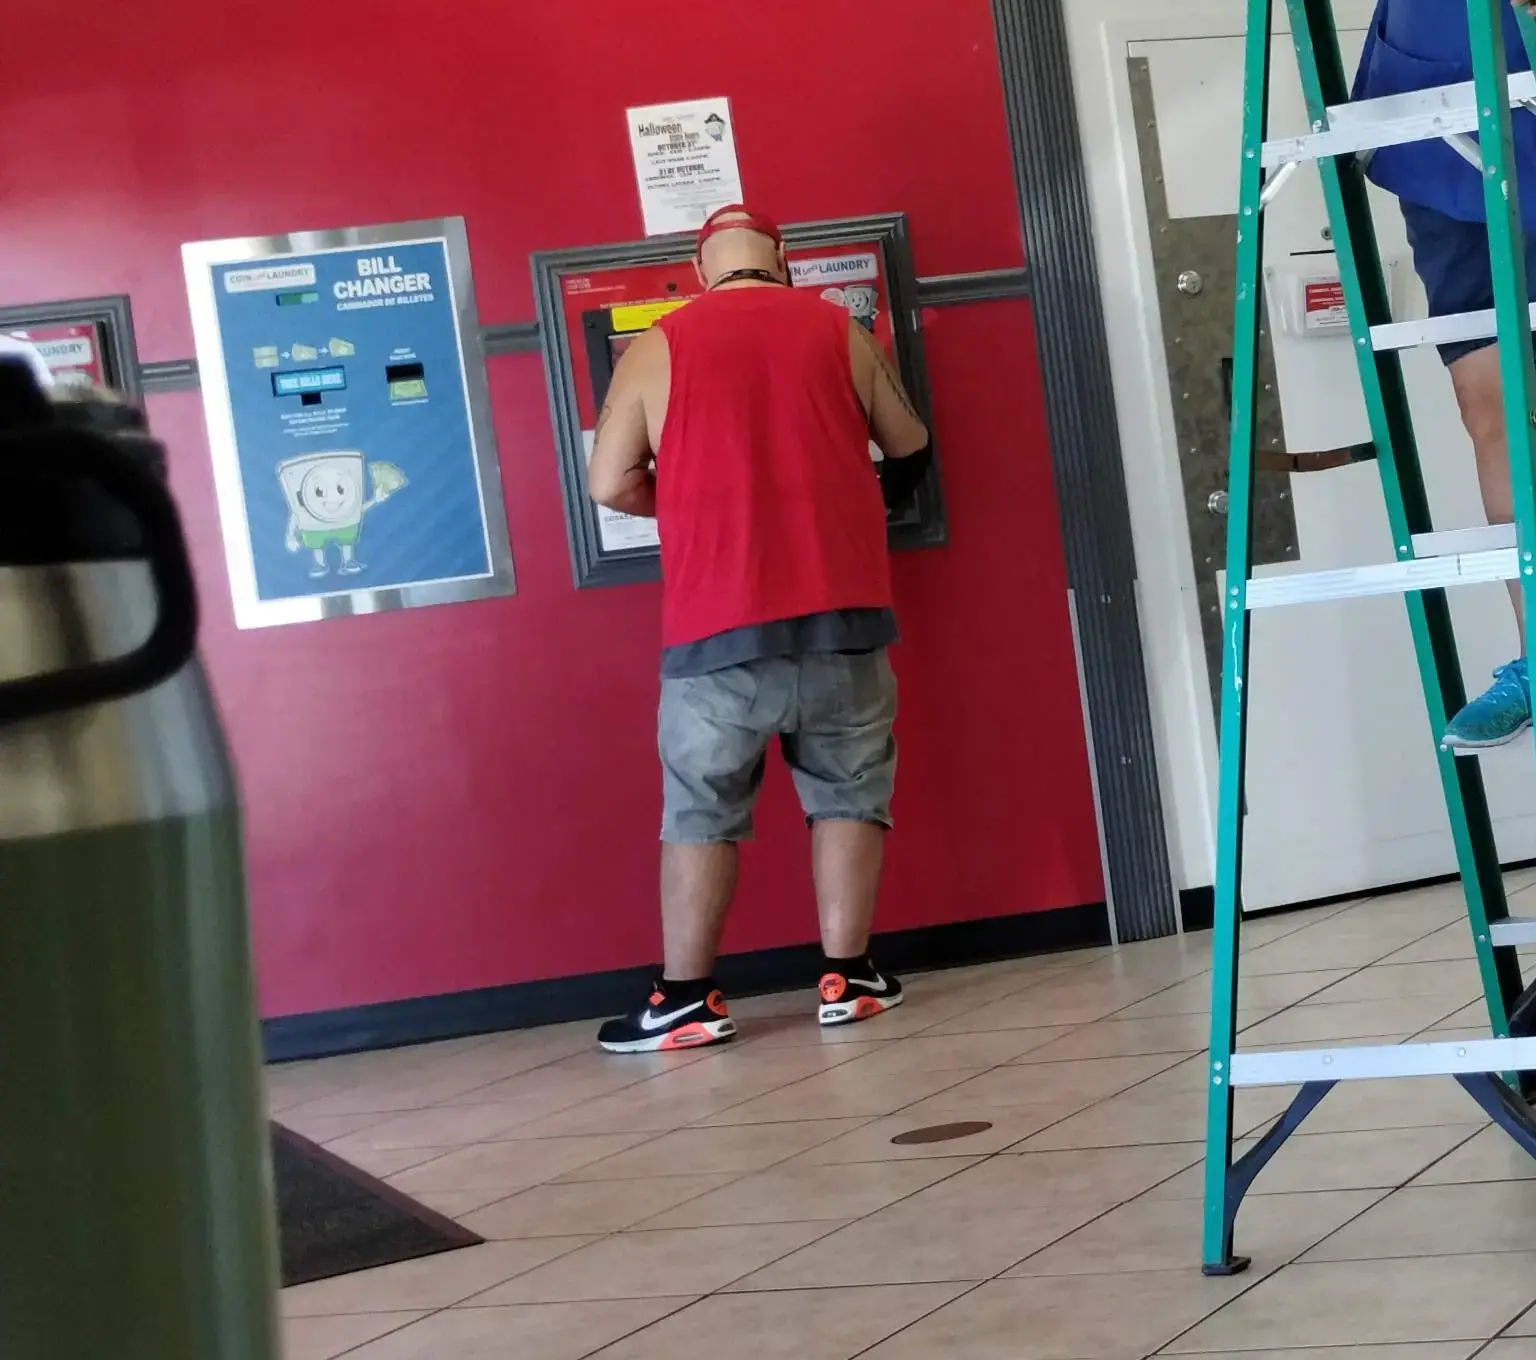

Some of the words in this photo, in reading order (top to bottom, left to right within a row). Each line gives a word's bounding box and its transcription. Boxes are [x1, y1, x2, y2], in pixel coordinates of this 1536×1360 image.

[638, 122, 682, 138] Halloween
[266, 266, 309, 280] LAUNDRY
[357, 255, 402, 277] BILL
[819, 259, 870, 274] LAUNDRY
[333, 272, 432, 300] CHANGER
[397, 292, 434, 305] BILLETES
[37, 343, 83, 357] UNDRY
